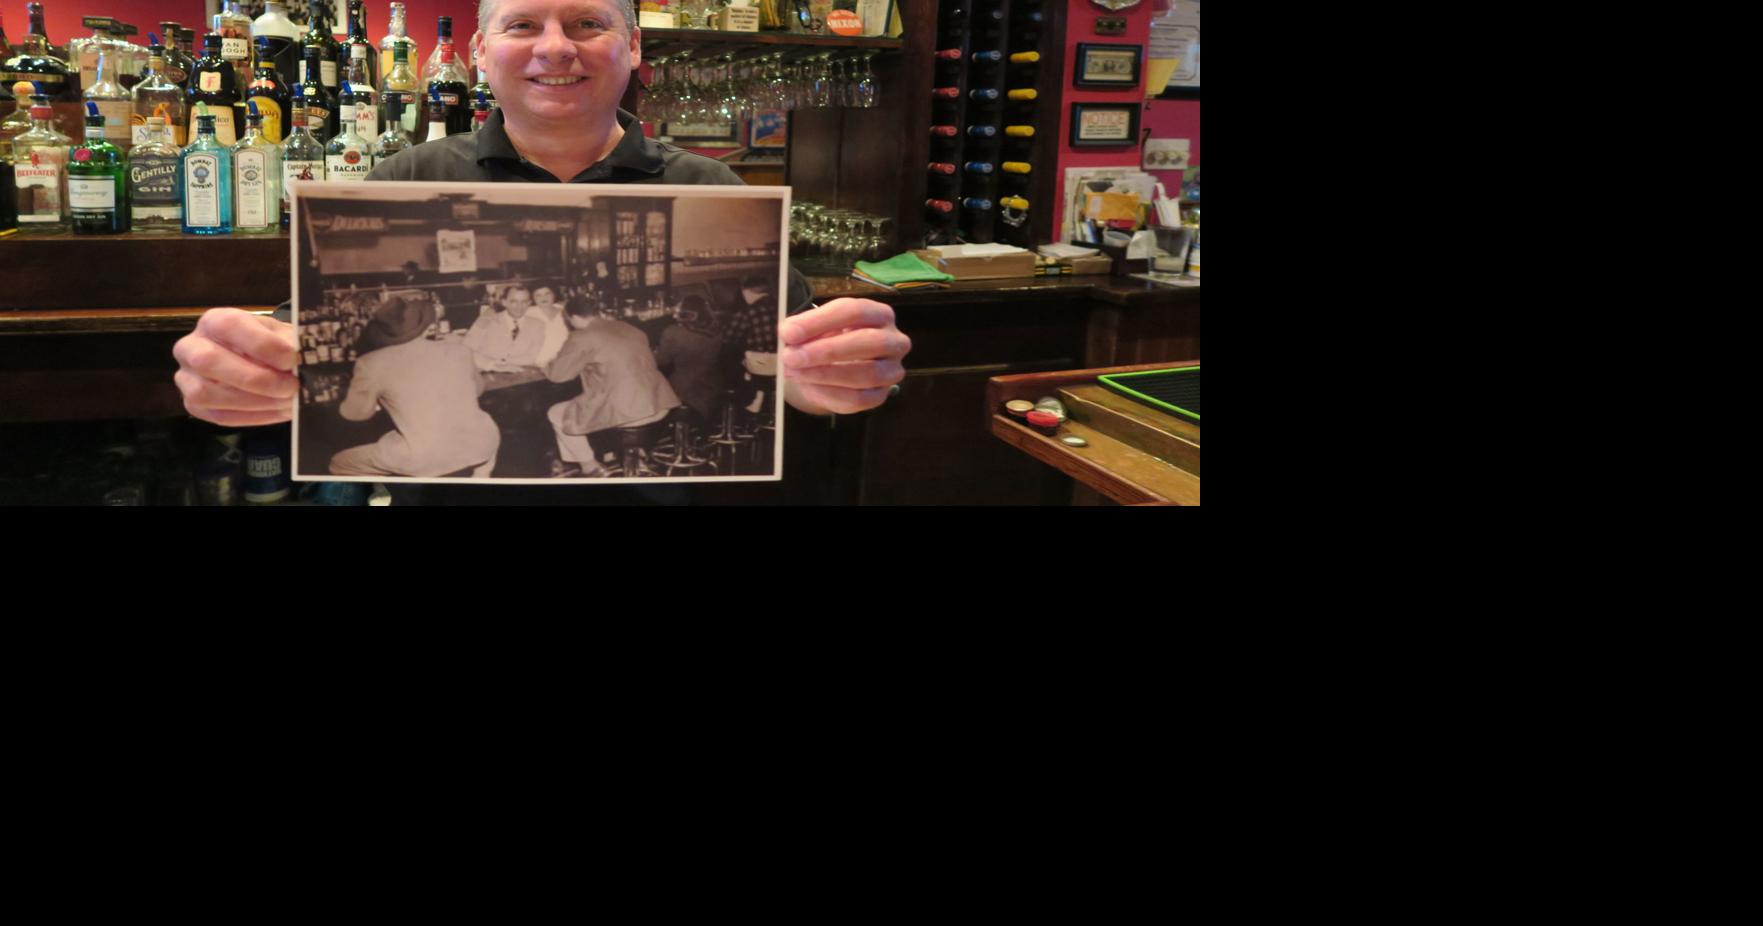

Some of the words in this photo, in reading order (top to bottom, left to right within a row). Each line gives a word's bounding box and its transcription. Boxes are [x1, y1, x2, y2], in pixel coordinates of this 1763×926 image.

[1082, 112, 1126, 125] NOTICE
[16, 169, 57, 178] BEEFEATER
[131, 165, 177, 183] GENTILLY
